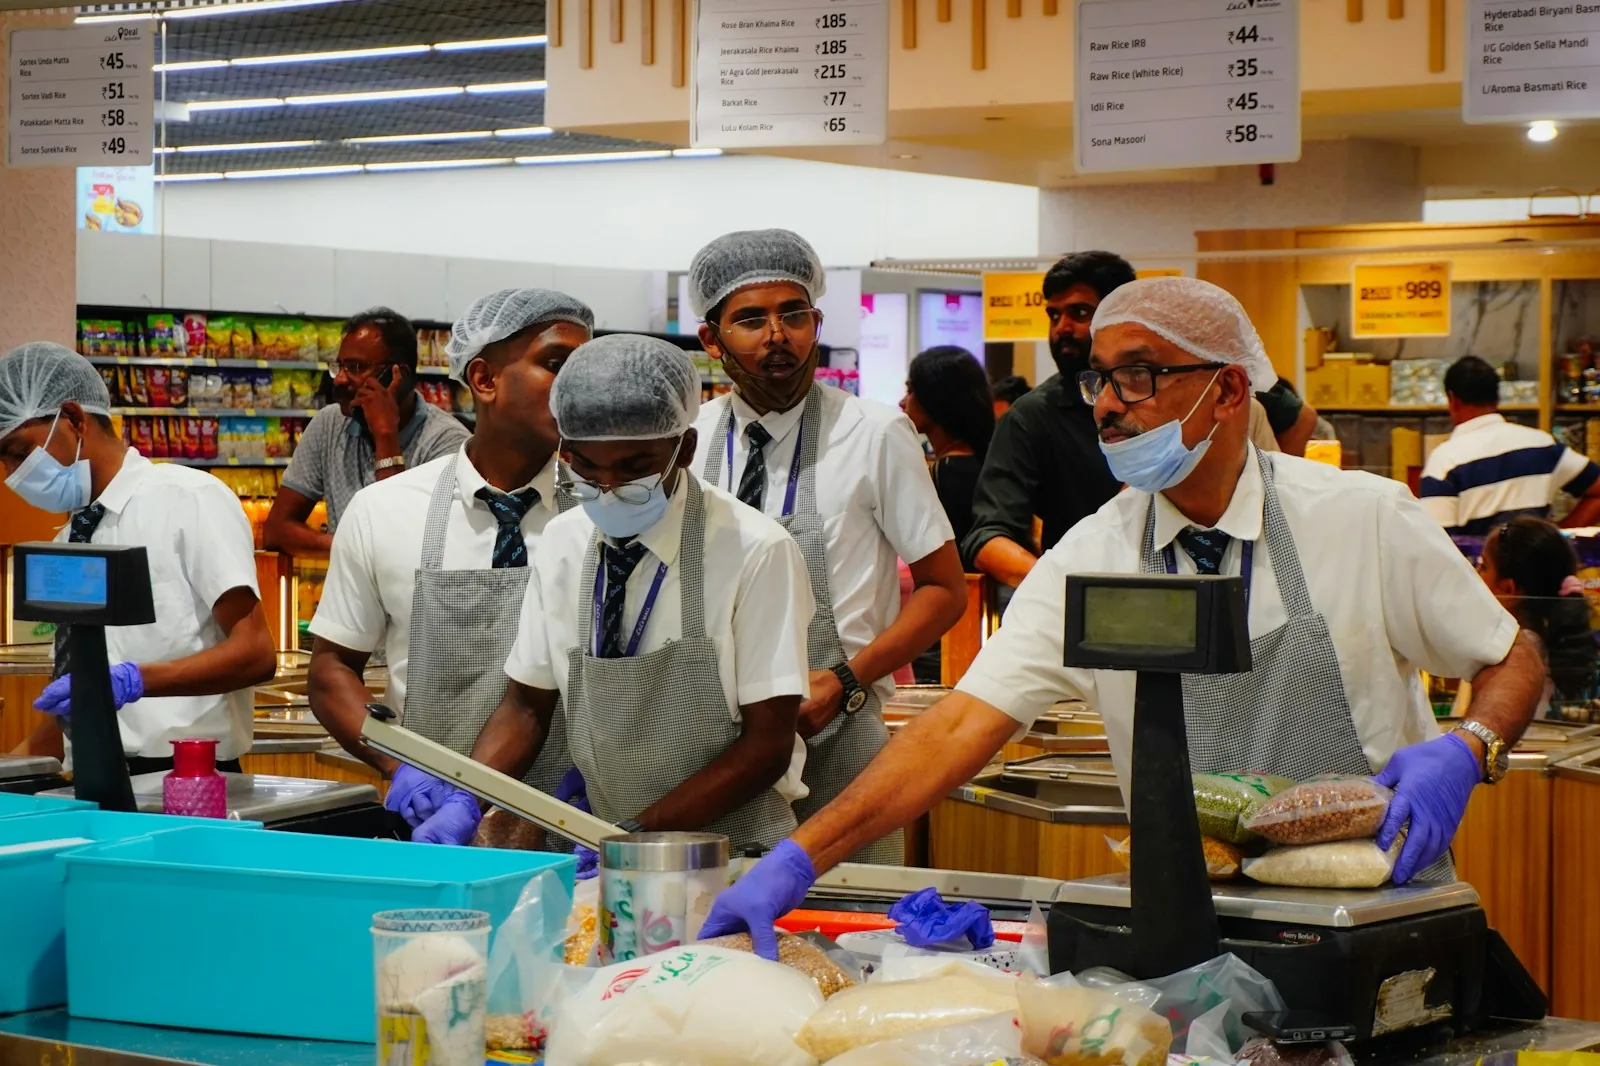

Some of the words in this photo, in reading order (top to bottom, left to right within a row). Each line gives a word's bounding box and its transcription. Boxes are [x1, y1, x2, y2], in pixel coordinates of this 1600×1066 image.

[815, 13, 846, 29] ₹185
[1484, 8, 1536, 22] Hyderabadi
[1540, 6, 1573, 17] Biryani
[756, 20, 779, 28] Khaima
[1485, 23, 1504, 31] Rice
[124, 28, 138, 36] Deal
[1228, 25, 1258, 44] ₹44
[721, 46, 757, 56] Jeerakasala
[759, 46, 772, 54] Rice
[774, 46, 799, 54] Khaima
[815, 40, 847, 55] ₹185
[1090, 42, 1109, 51] Raw
[1111, 40, 1129, 50] Rice
[1499, 42, 1531, 52] Golden
[1534, 40, 1556, 50] Sella
[1559, 38, 1588, 48] Mandi
[20, 58, 37, 66] Sortex
[100, 52, 124, 70] ₹45
[1483, 56, 1502, 64] Rice
[730, 68, 744, 77] Agra
[746, 68, 760, 76] Gold
[761, 68, 798, 76] Jeerakasala
[814, 65, 846, 80] ₹215
[1090, 72, 1109, 81] Raw
[1111, 70, 1130, 80] Rice
[1132, 68, 1160, 80] (White
[1163, 66, 1183, 76] Rice)
[1228, 58, 1258, 78] ₹35
[101, 82, 124, 100] ₹51
[1524, 81, 1563, 92] Basmati
[1566, 81, 1587, 90] Rice
[722, 99, 743, 107] Barkat
[823, 92, 846, 106] ₹77
[1227, 92, 1258, 111] ₹45
[1091, 103, 1104, 112] Idli
[1107, 102, 1124, 110] Rice
[20, 118, 52, 126] Palakkadan
[101, 109, 124, 126] ₹58
[739, 124, 758, 132] Kolam
[823, 118, 846, 132] ₹65
[1091, 138, 1112, 146] Sona
[1114, 134, 1146, 145] Masoori
[1226, 124, 1257, 143] ₹58
[102, 137, 125, 154] ₹49
